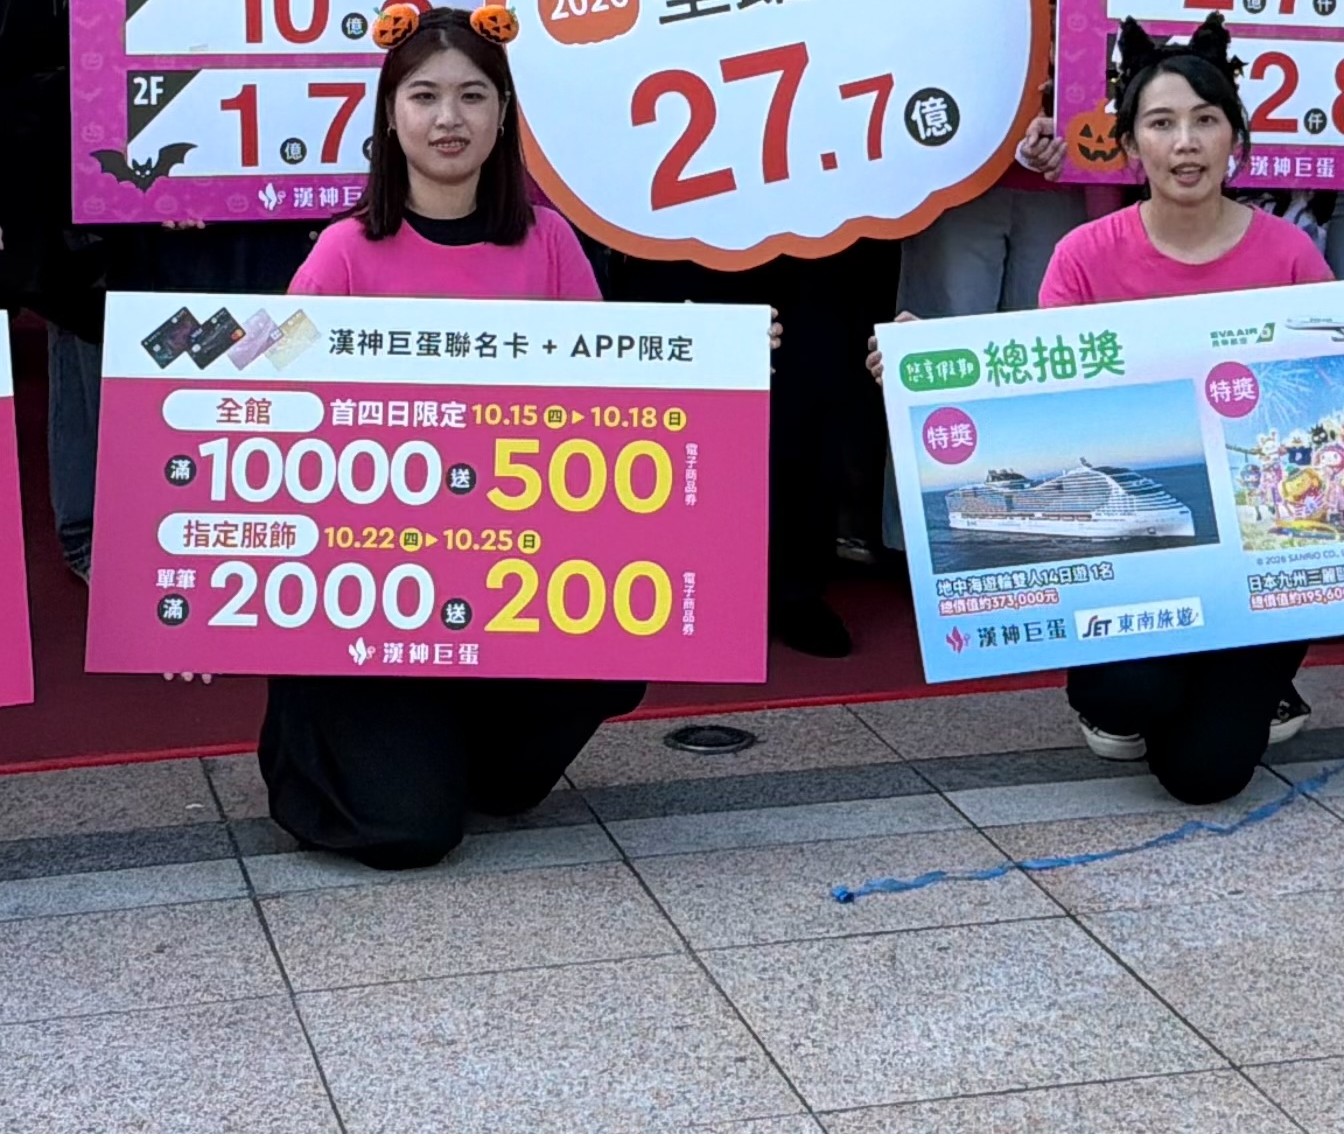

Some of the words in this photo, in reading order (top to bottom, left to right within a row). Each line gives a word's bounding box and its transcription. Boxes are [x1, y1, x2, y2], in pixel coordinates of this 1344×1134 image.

[133, 77, 164, 105] 2F
[631, 41, 960, 212] 27.7億
[1250, 155, 1335, 178] 漢神巨蛋
[328, 328, 529, 359] 漢神巨蛋聯名卡
[984, 329, 1125, 387] 總抽獎
[1209, 377, 1256, 404] 特獎
[215, 397, 272, 426] 全館
[330, 400, 467, 429] 首四日限定
[927, 422, 974, 450] 特獎
[685, 443, 698, 507] 電子商品券
[183, 519, 296, 550] 指定服飾
[156, 568, 196, 590] 單筆
[682, 572, 695, 636] 電子商品券
[977, 617, 1067, 648] 漢神巨蛋
[1117, 606, 1199, 633] 東南旅遊
[382, 642, 481, 666] 漢神巨蛋
